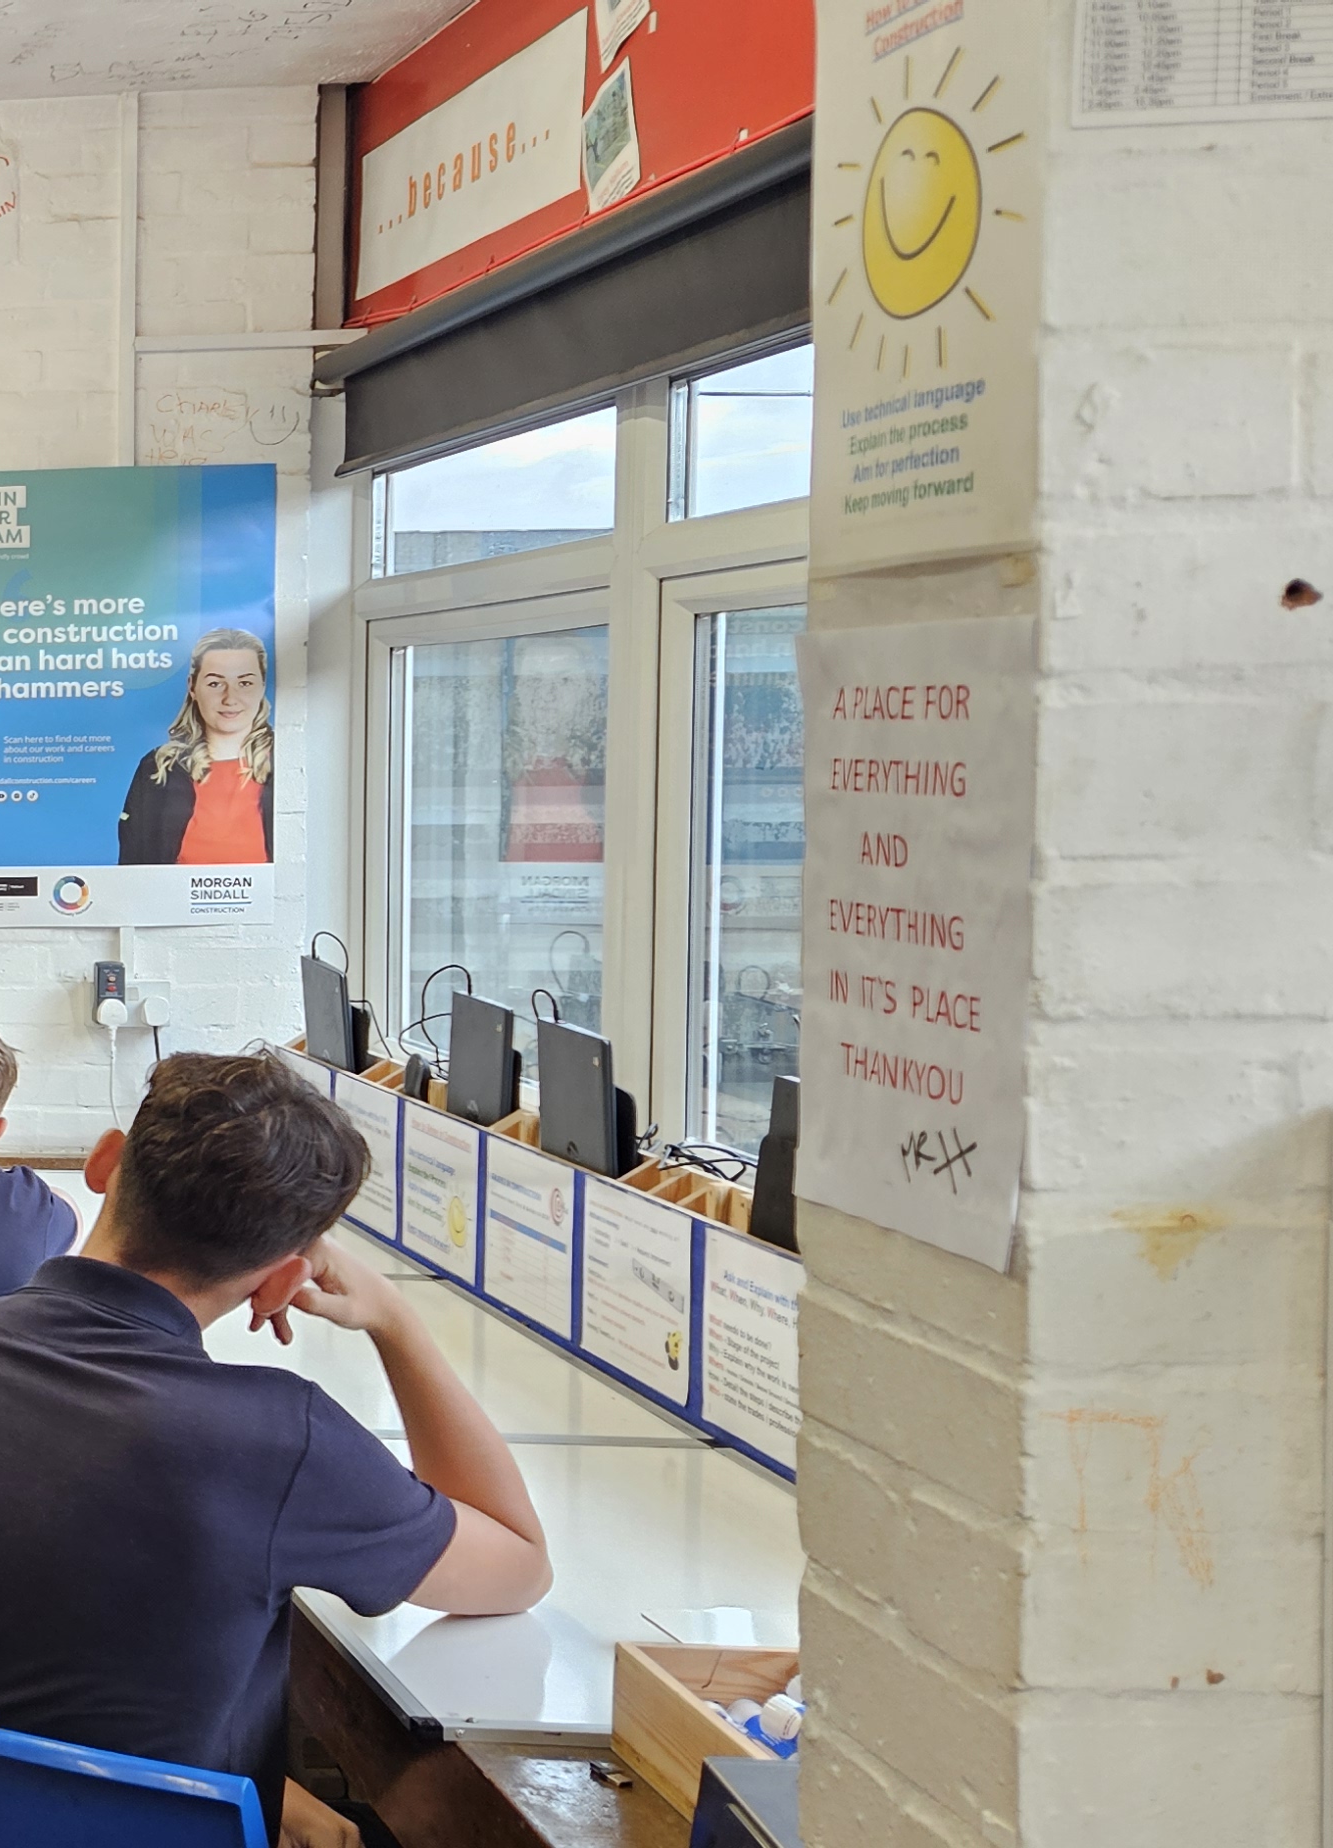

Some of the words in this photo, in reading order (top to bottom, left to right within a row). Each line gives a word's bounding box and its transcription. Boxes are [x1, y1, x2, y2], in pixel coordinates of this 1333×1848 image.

[842, 408, 862, 430] Use
[864, 391, 911, 422] technical
[913, 378, 986, 409] language
[849, 431, 886, 457] Explain
[889, 424, 906, 445] the
[909, 412, 969, 444] process
[853, 462, 873, 484] Aim
[875, 457, 889, 478] for
[891, 445, 960, 479] perfection
[844, 494, 870, 515] Keep
[871, 484, 910, 509] moving
[913, 470, 975, 501] forward
[73, 596, 145, 615] more
[3, 619, 178, 644] construction
[39, 648, 103, 671] hard
[111, 647, 173, 669] hats
[833, 686, 846, 720] A
[853, 685, 916, 721] PLACE
[925, 684, 970, 720] FOR
[3, 736, 23, 744] Scan
[25, 735, 43, 744] here
[45, 736, 53, 744] to
[55, 735, 72, 743] find
[73, 735, 87, 743] out
[3, 745, 28, 754] about
[45, 745, 66, 753] work
[67, 745, 83, 753] and
[84, 745, 115, 753] careers
[3, 755, 11, 763] in
[13, 754, 64, 764] construction
[830, 757, 967, 798] EVERYTHING
[861, 831, 909, 868] AND
[190, 877, 252, 888] MORGAN
[190, 889, 249, 900] SINDALL
[190, 906, 245, 915] CONSTRUCTION
[828, 898, 965, 951] EVERYTHING
[830, 968, 849, 1005] IN
[911, 984, 981, 1033] PLACE
[840, 1041, 964, 1106] THANKYOU
